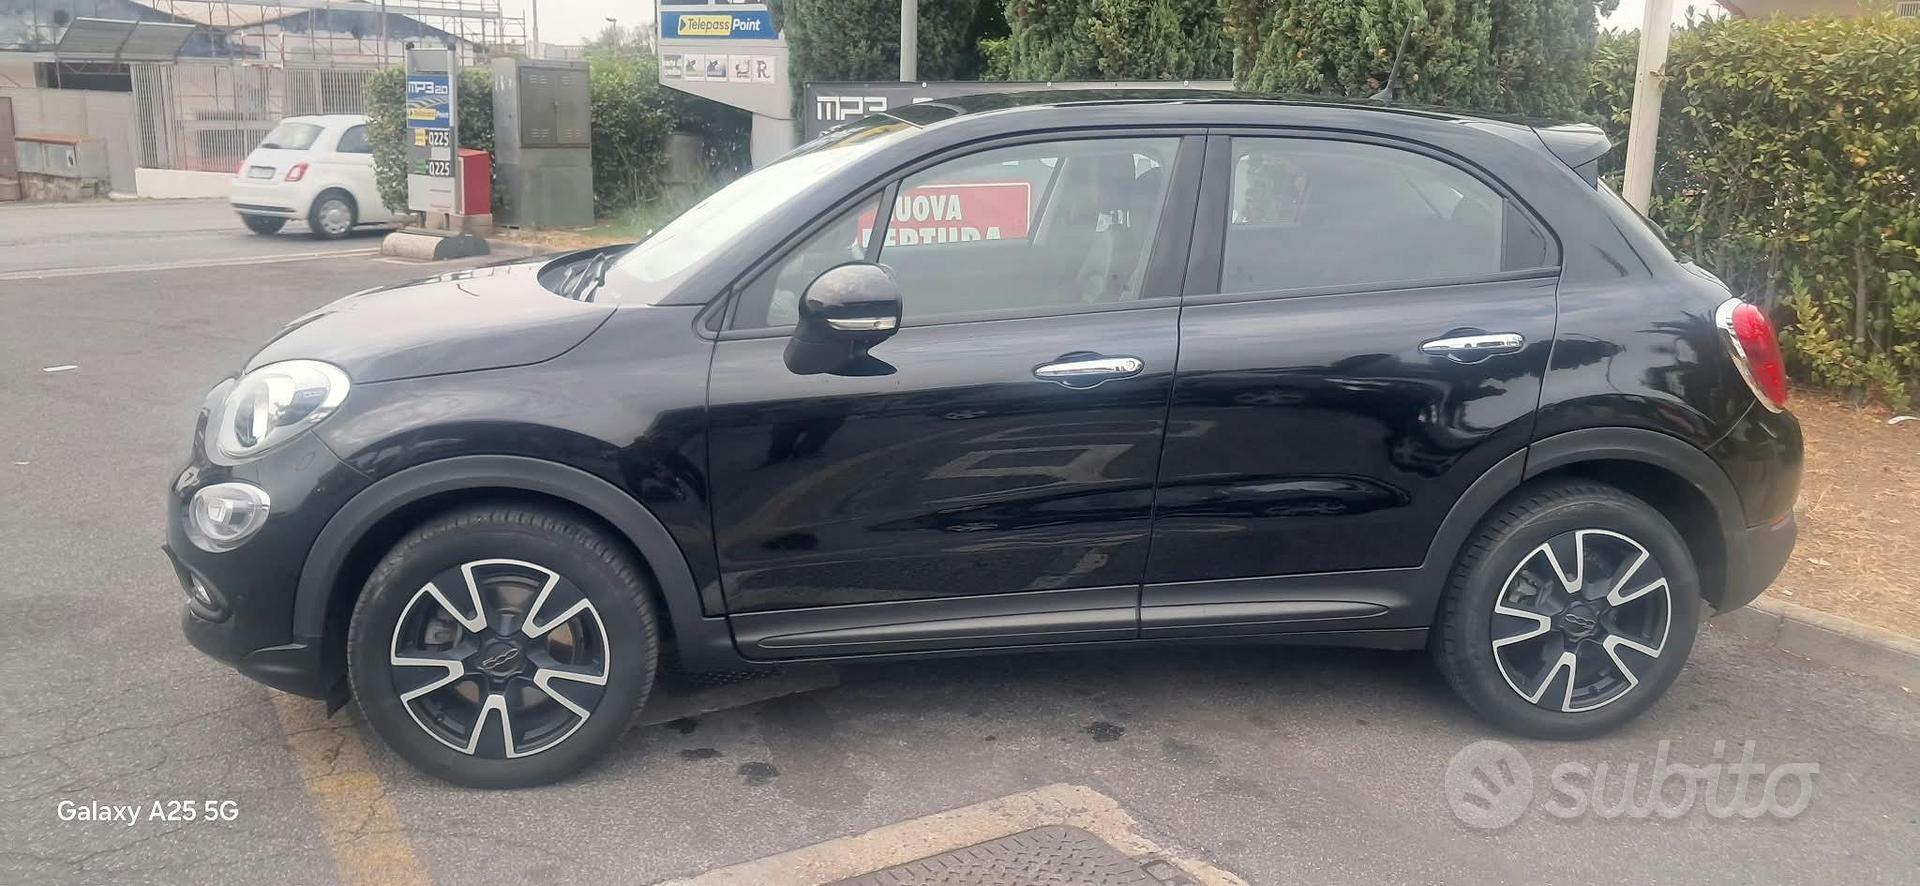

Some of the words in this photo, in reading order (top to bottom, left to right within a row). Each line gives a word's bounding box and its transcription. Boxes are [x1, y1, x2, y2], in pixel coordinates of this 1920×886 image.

[687, 18, 730, 32] Telepass
[732, 18, 761, 31] Point
[408, 81, 434, 94] MP3
[890, 195, 962, 222] UOVA
